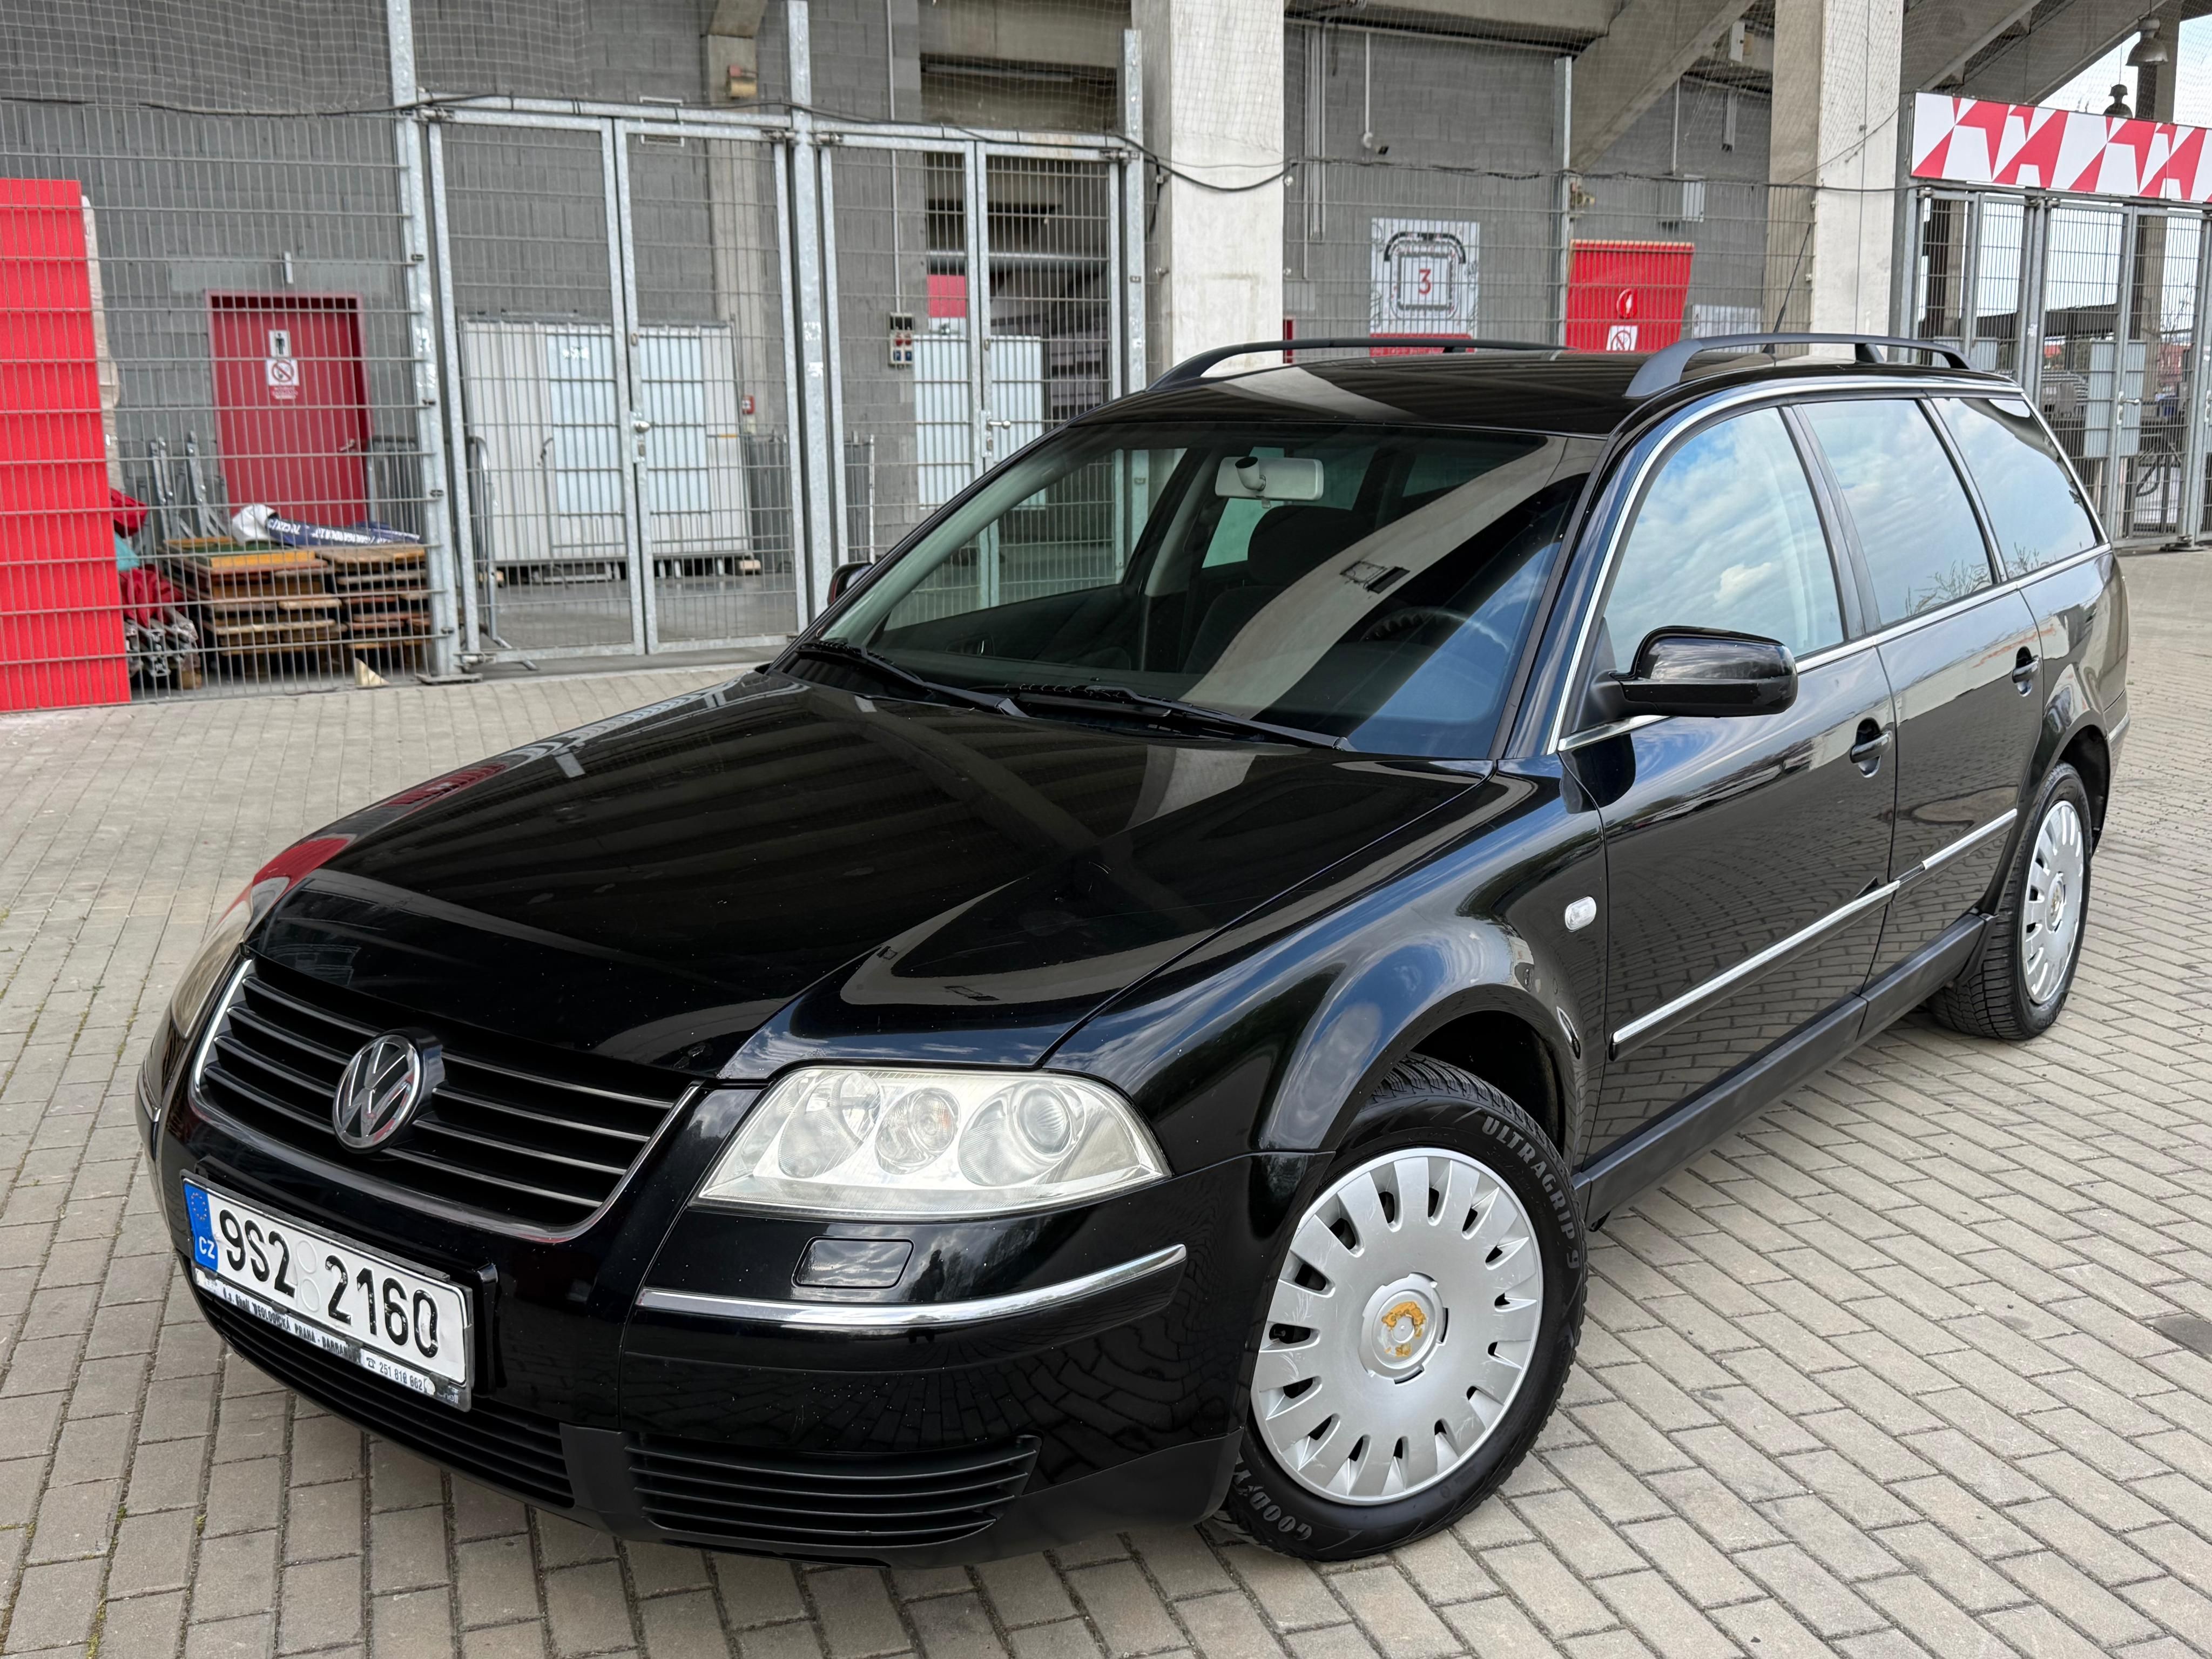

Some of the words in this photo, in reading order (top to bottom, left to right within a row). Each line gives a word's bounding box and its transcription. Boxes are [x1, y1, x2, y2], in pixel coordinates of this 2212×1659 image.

[1418, 268, 1432, 295] 3
[1481, 1116, 1576, 1240] ULTRAGRIP
[1566, 1249, 1580, 1270] 9
[199, 1237, 215, 1260] CZ
[219, 1209, 295, 1297] 9S2
[325, 1254, 439, 1359] 2160
[294, 1323, 316, 1343] PRAHA
[379, 1361, 392, 1377] 251
